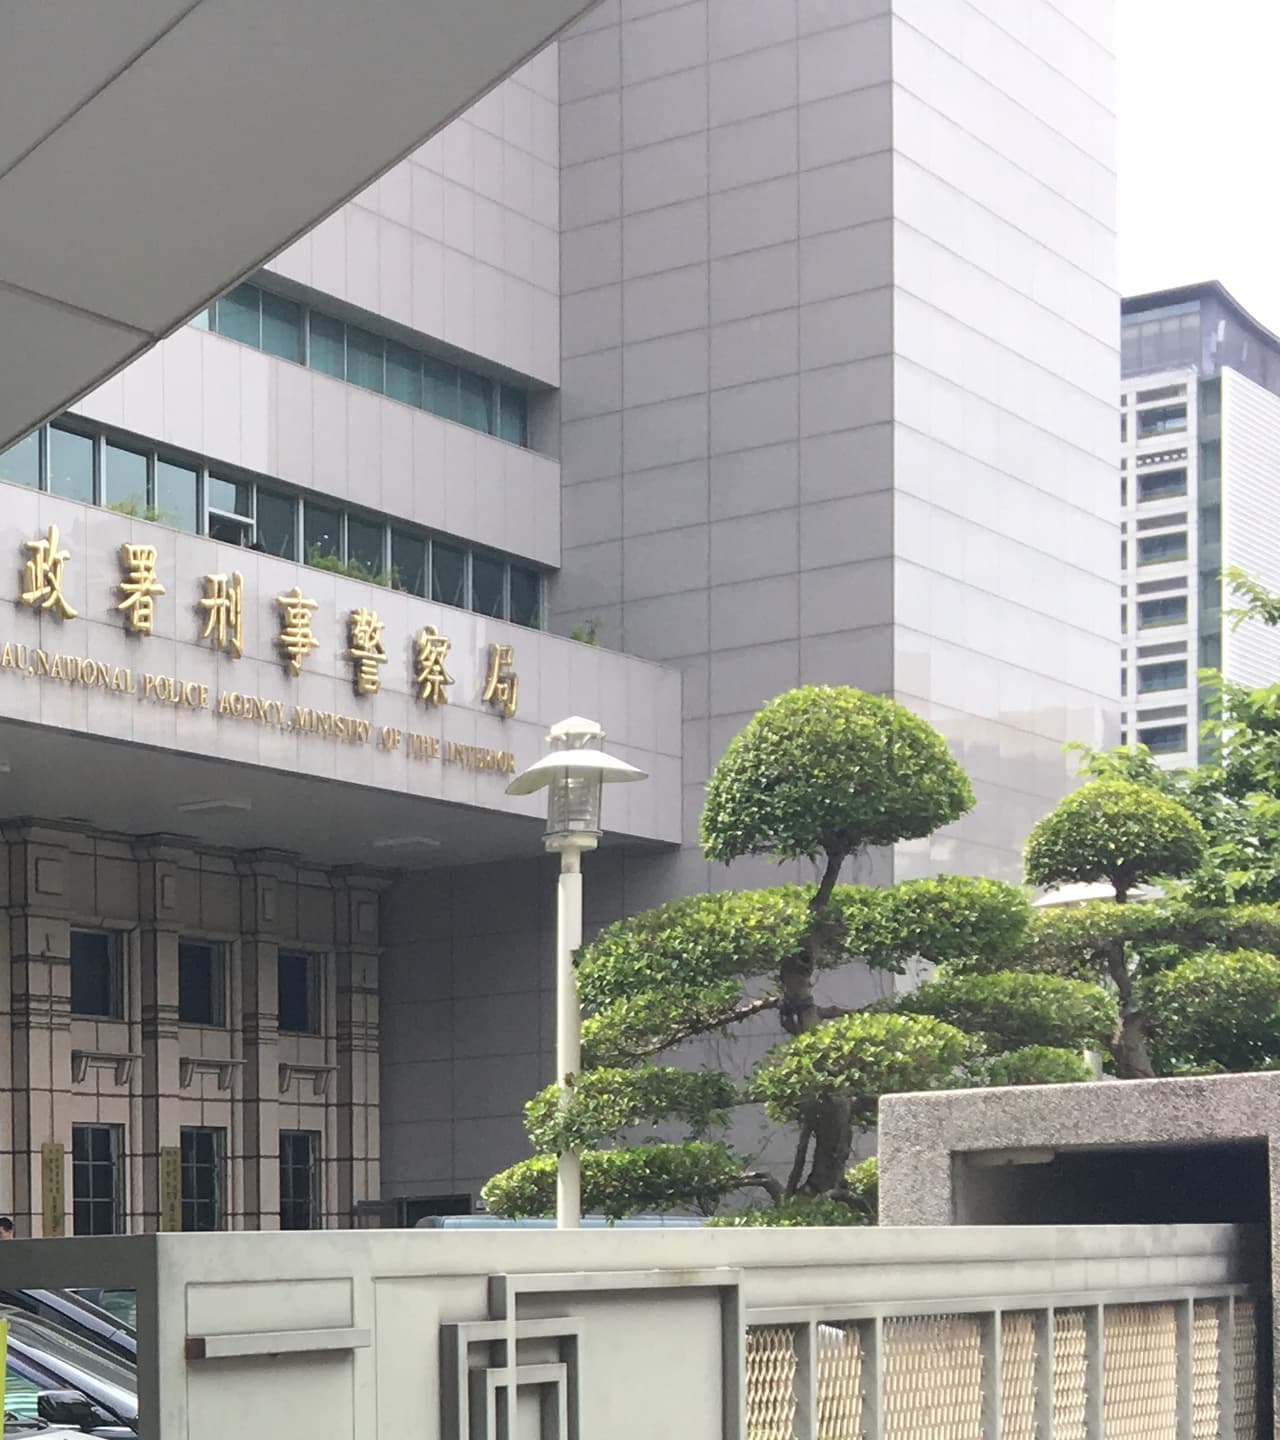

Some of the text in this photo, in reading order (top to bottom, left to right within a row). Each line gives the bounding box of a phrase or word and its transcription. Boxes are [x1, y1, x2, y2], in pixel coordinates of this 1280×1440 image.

[144, 673, 209, 709] POLICE
[407, 732, 441, 757] THE
[447, 741, 516, 773] INTERIOR
